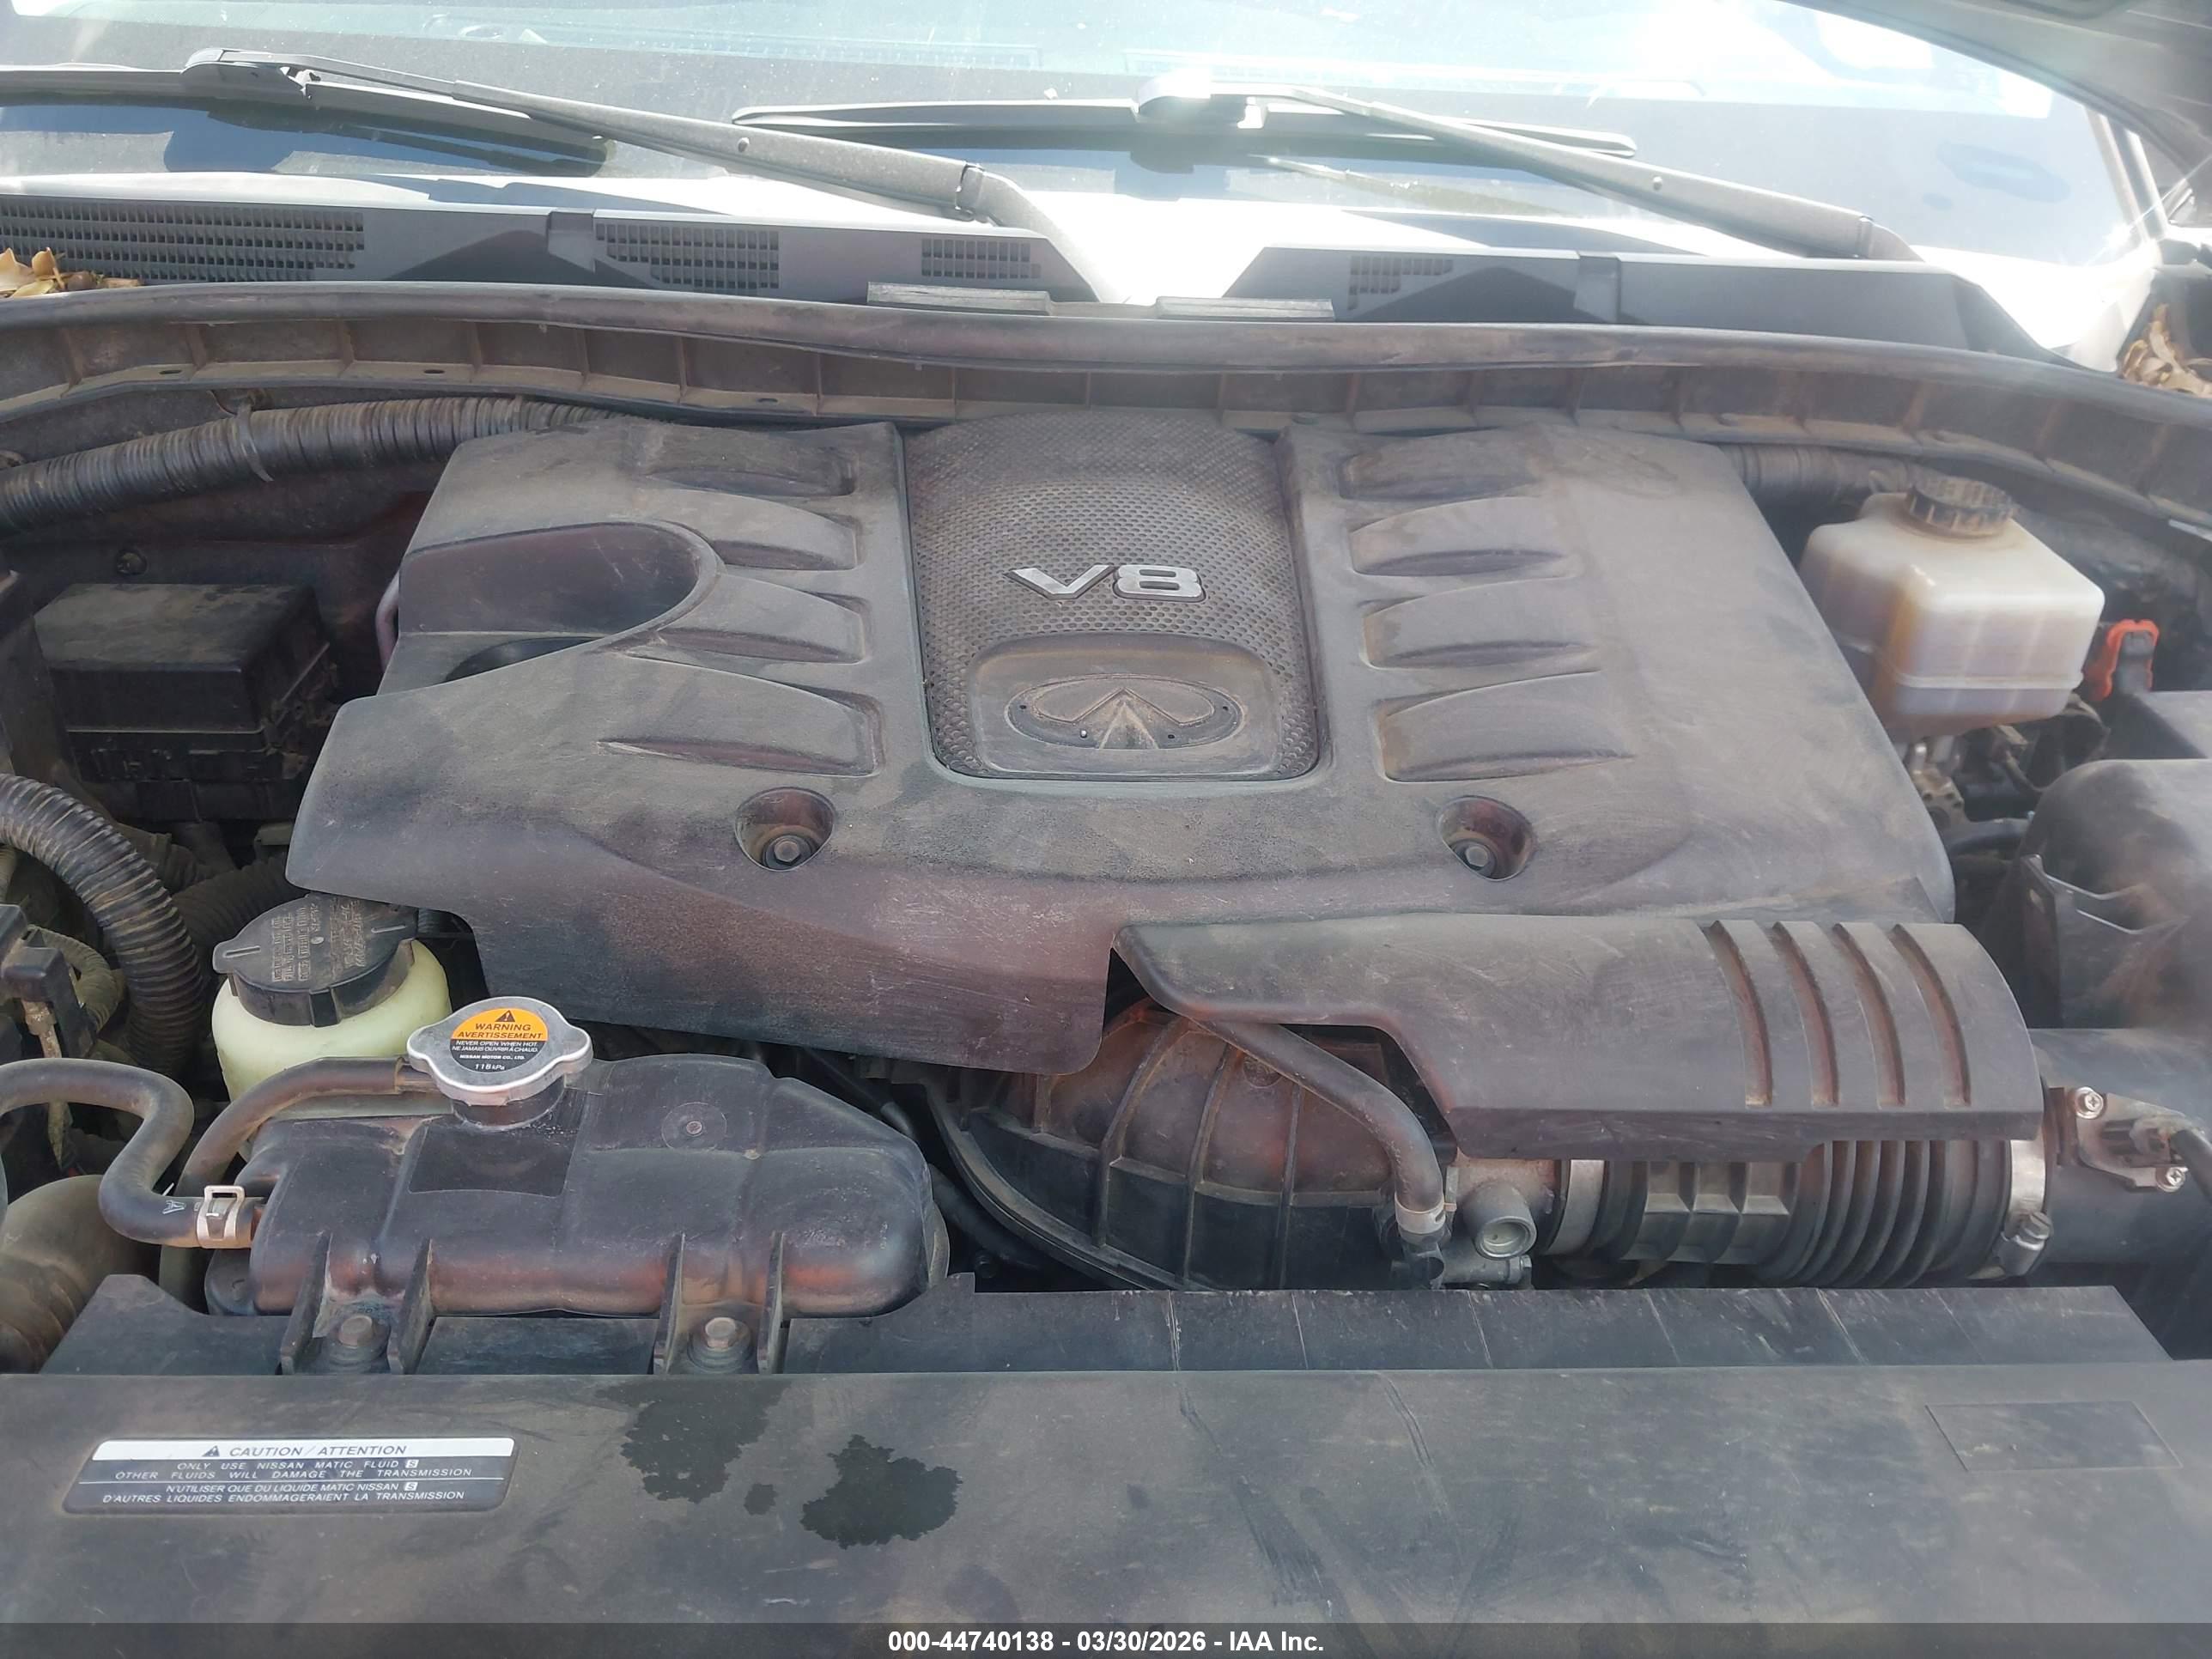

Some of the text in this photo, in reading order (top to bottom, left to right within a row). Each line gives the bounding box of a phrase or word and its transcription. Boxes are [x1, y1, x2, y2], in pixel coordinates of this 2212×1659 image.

[1003, 564, 1206, 603] V8
[475, 1023, 531, 1031] WARNING
[229, 1446, 303, 1457] CAUTION
[318, 1445, 407, 1456] ATTENTION
[177, 1462, 210, 1471] ONLY
[221, 1462, 246, 1470] USE
[257, 1462, 304, 1470] NISSAN
[315, 1461, 353, 1469] MATIC
[364, 1460, 399, 1468] FLUID
[271, 1470, 326, 1479] DAMAGE
[378, 1468, 472, 1477] TRANSMISSION
[166, 1485, 226, 1493] N'UTILISER
[228, 1484, 252, 1493] QUE
[254, 1484, 272, 1492] DU
[273, 1484, 318, 1492] LIQUIDE
[356, 1483, 399, 1492] NISSAN
[102, 1491, 465, 1503] D'AUTRES LIQUIDES ENDOMMAGERAIENT LA TRANSMISSION
